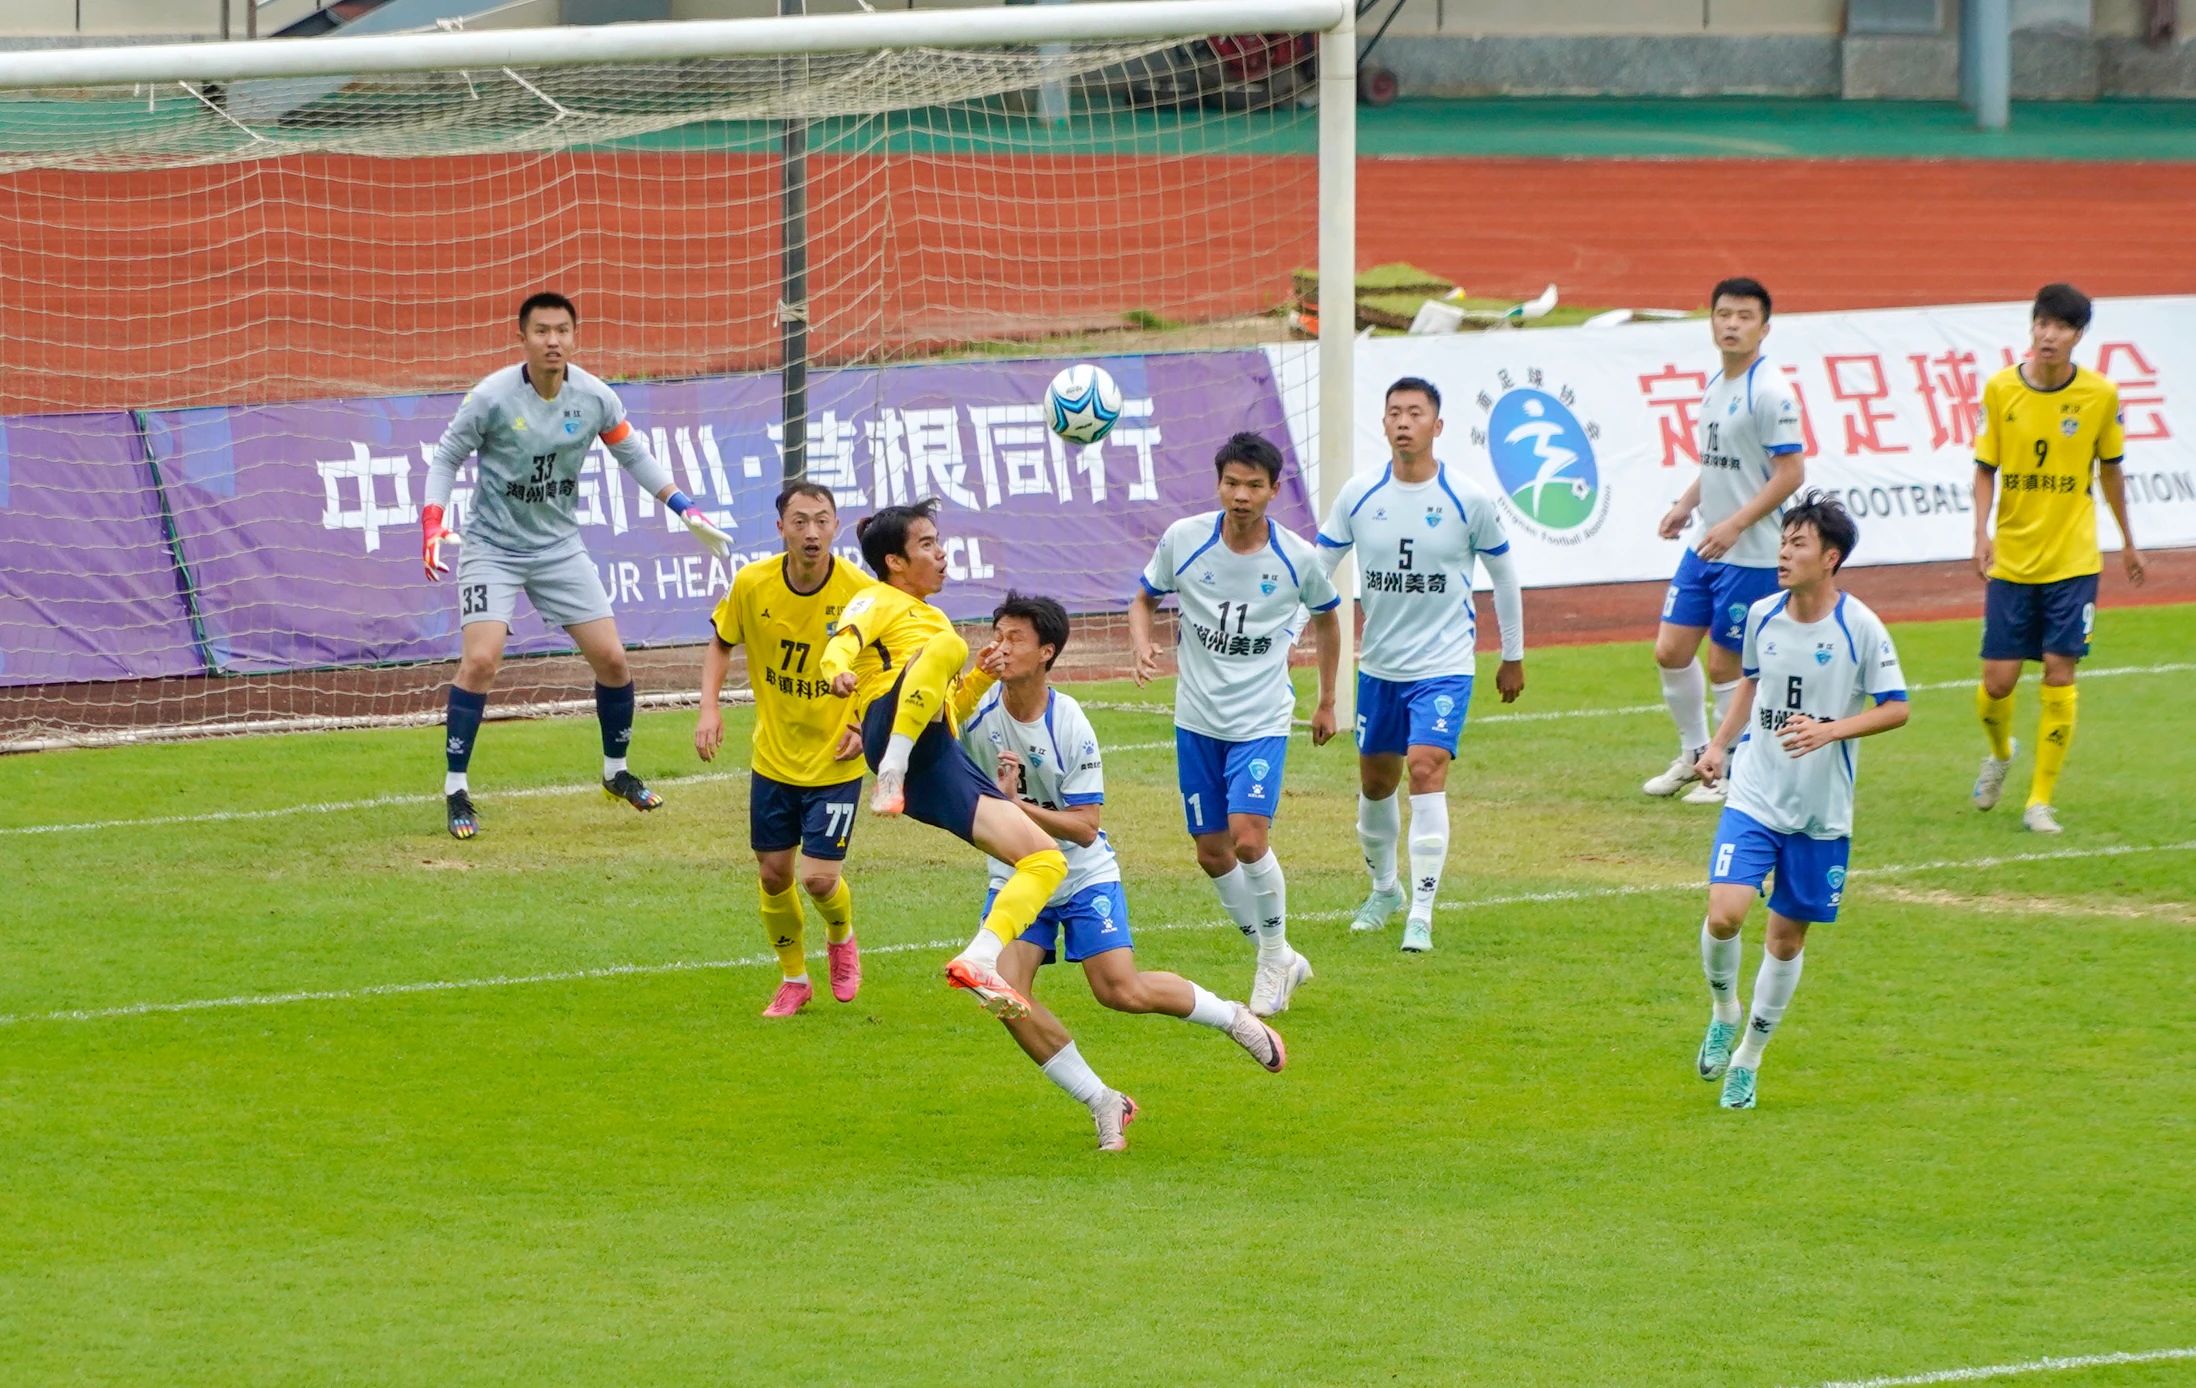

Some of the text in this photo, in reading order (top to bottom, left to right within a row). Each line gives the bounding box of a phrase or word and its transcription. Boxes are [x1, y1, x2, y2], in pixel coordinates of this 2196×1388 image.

[1638, 342, 2173, 467] 定足球会
[531, 453, 557, 485] 33
[2034, 439, 2049, 468] 9
[506, 479, 576, 504] 湖州美奇
[1828, 480, 1972, 519] OOTBAL
[1398, 538, 1414, 570] 5
[1366, 570, 1448, 594] 湖州美奇
[462, 584, 488, 616] 33
[1218, 600, 1249, 635] 11
[2082, 601, 2096, 635] 9
[1193, 622, 1273, 656] 湖州美奇
[781, 639, 811, 674] 77
[1786, 675, 1803, 710] 6
[1759, 707, 1835, 731] 湖州
[825, 802, 855, 837] 77
[1714, 843, 1735, 877] 6
